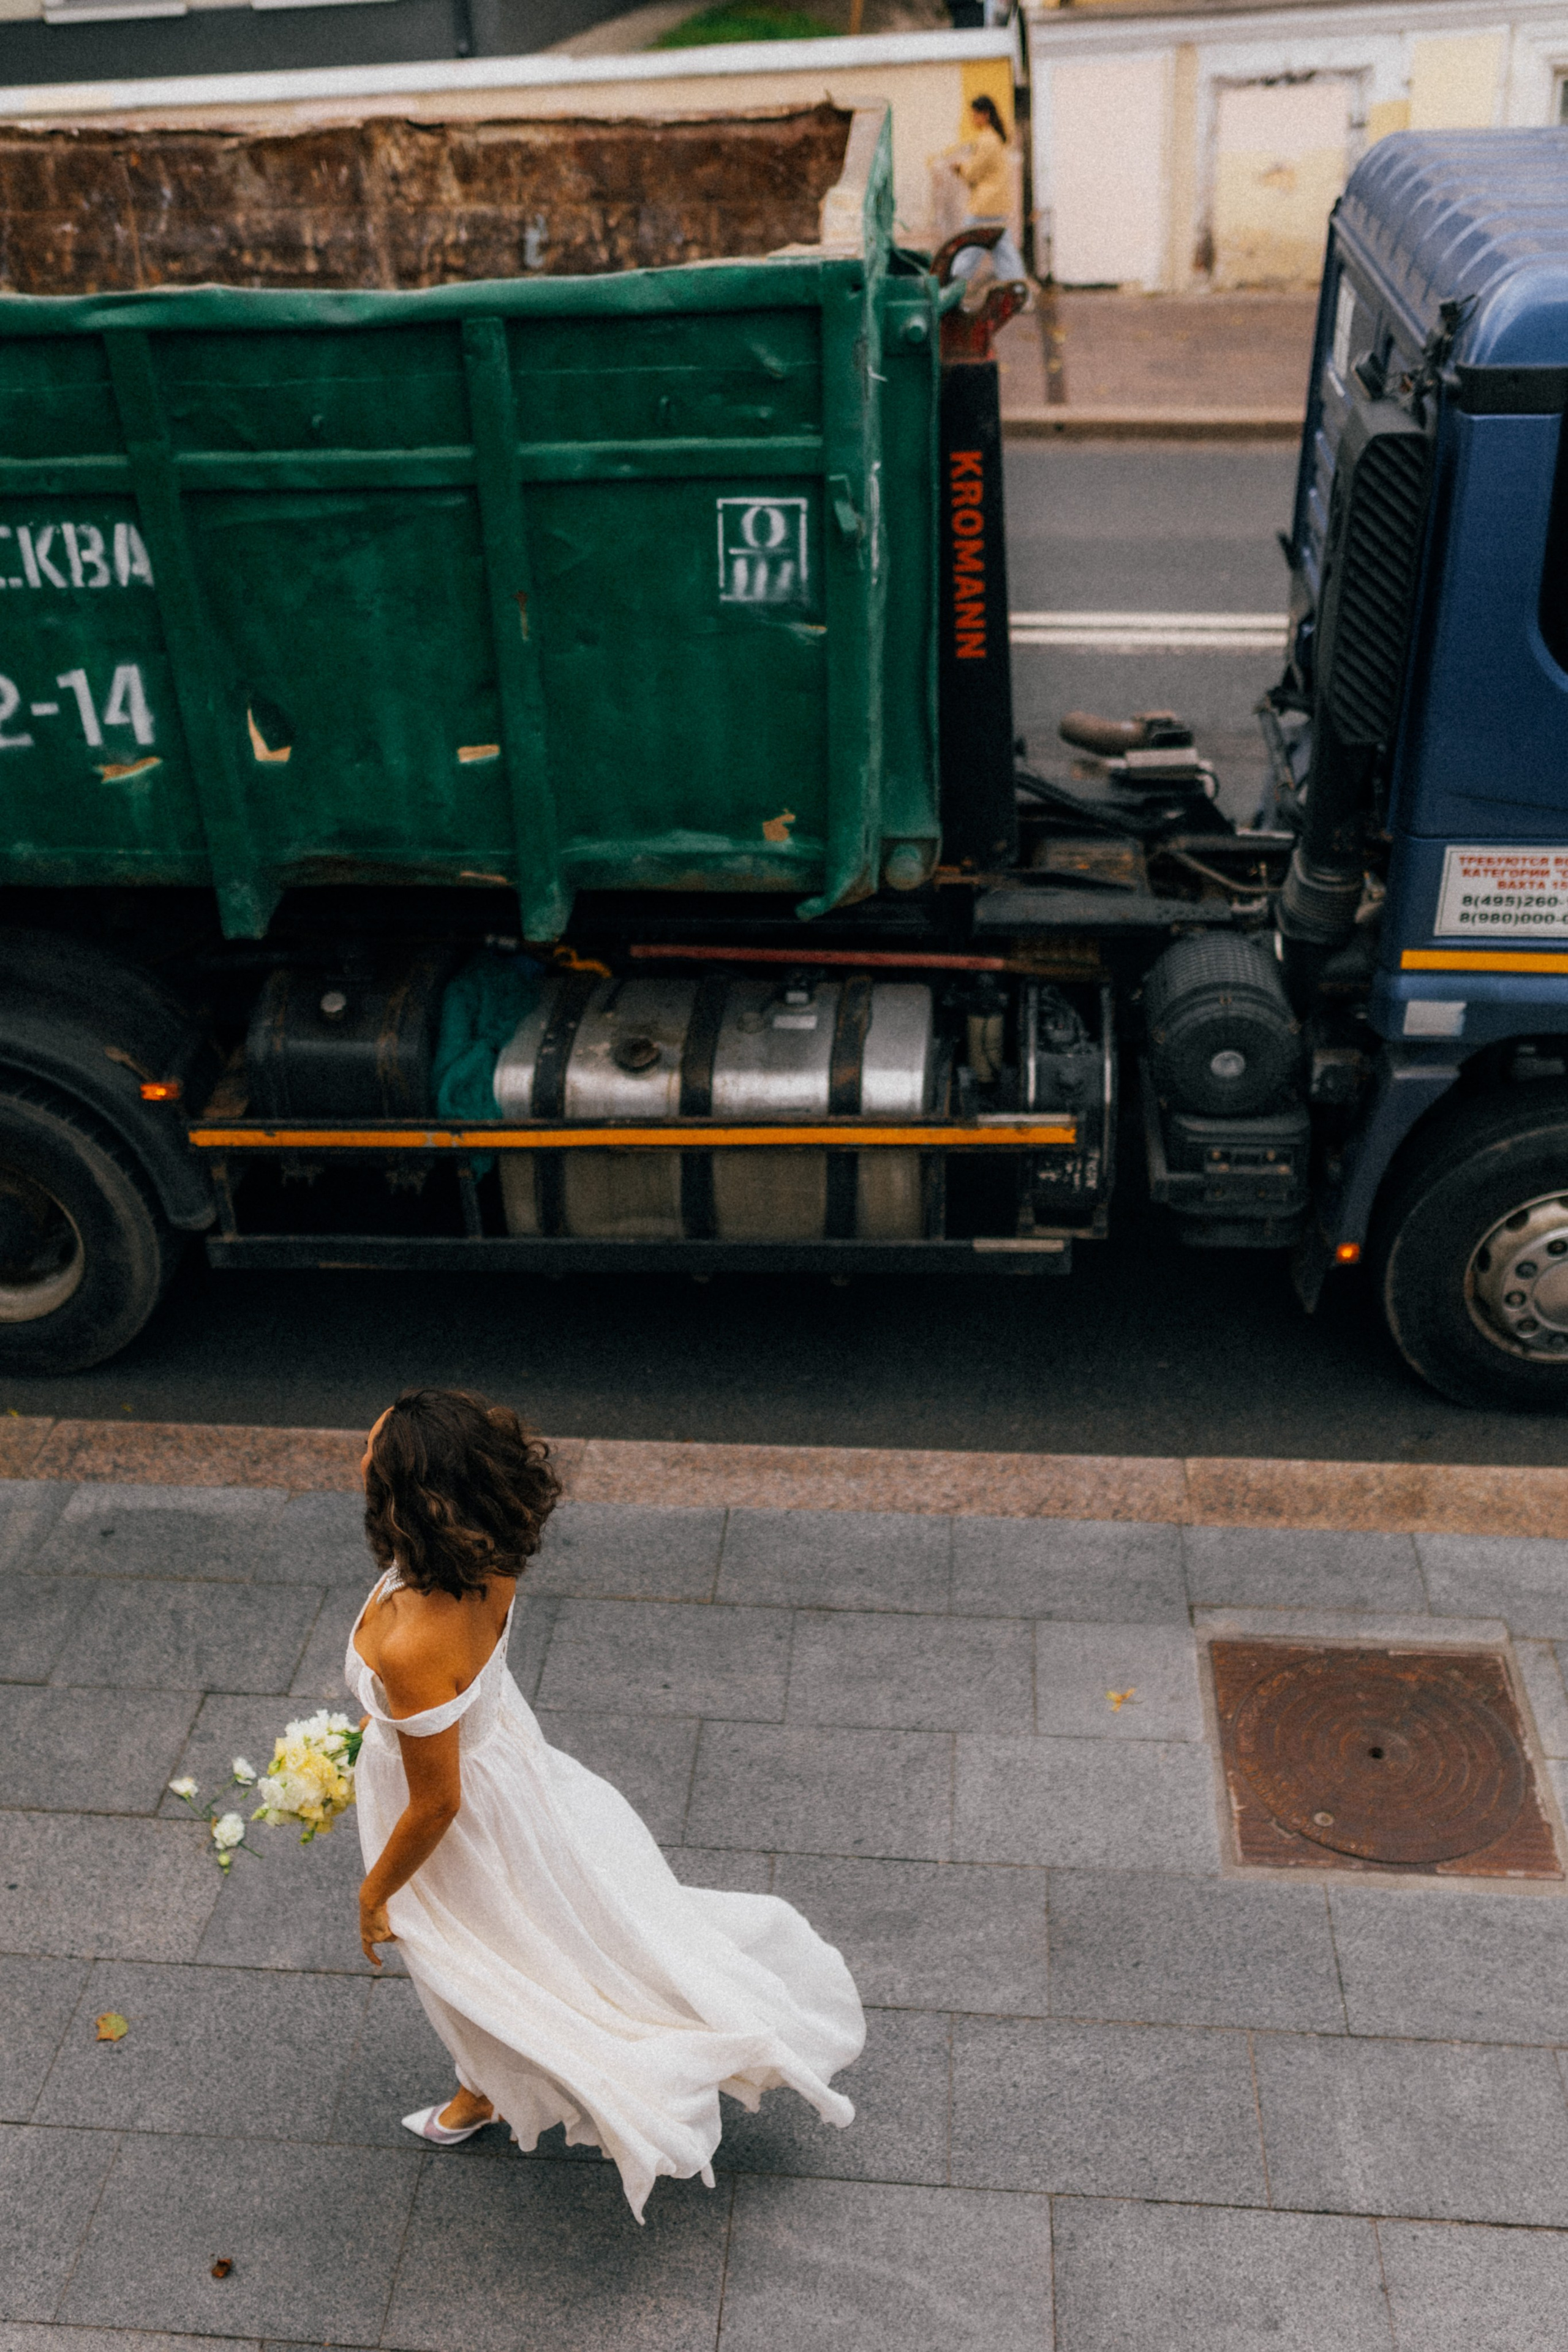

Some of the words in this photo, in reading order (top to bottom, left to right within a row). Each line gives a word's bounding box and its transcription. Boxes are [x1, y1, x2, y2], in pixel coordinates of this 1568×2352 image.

[949, 451, 986, 659] KROMANN
[1460, 856, 1549, 866] ТРЕБУЮТСЯ
[1462, 868, 1550, 878] КАТЕГОРИИ
[1497, 880, 1546, 890] ВАХТА
[1461, 895, 1568, 909] 8(495)260-
